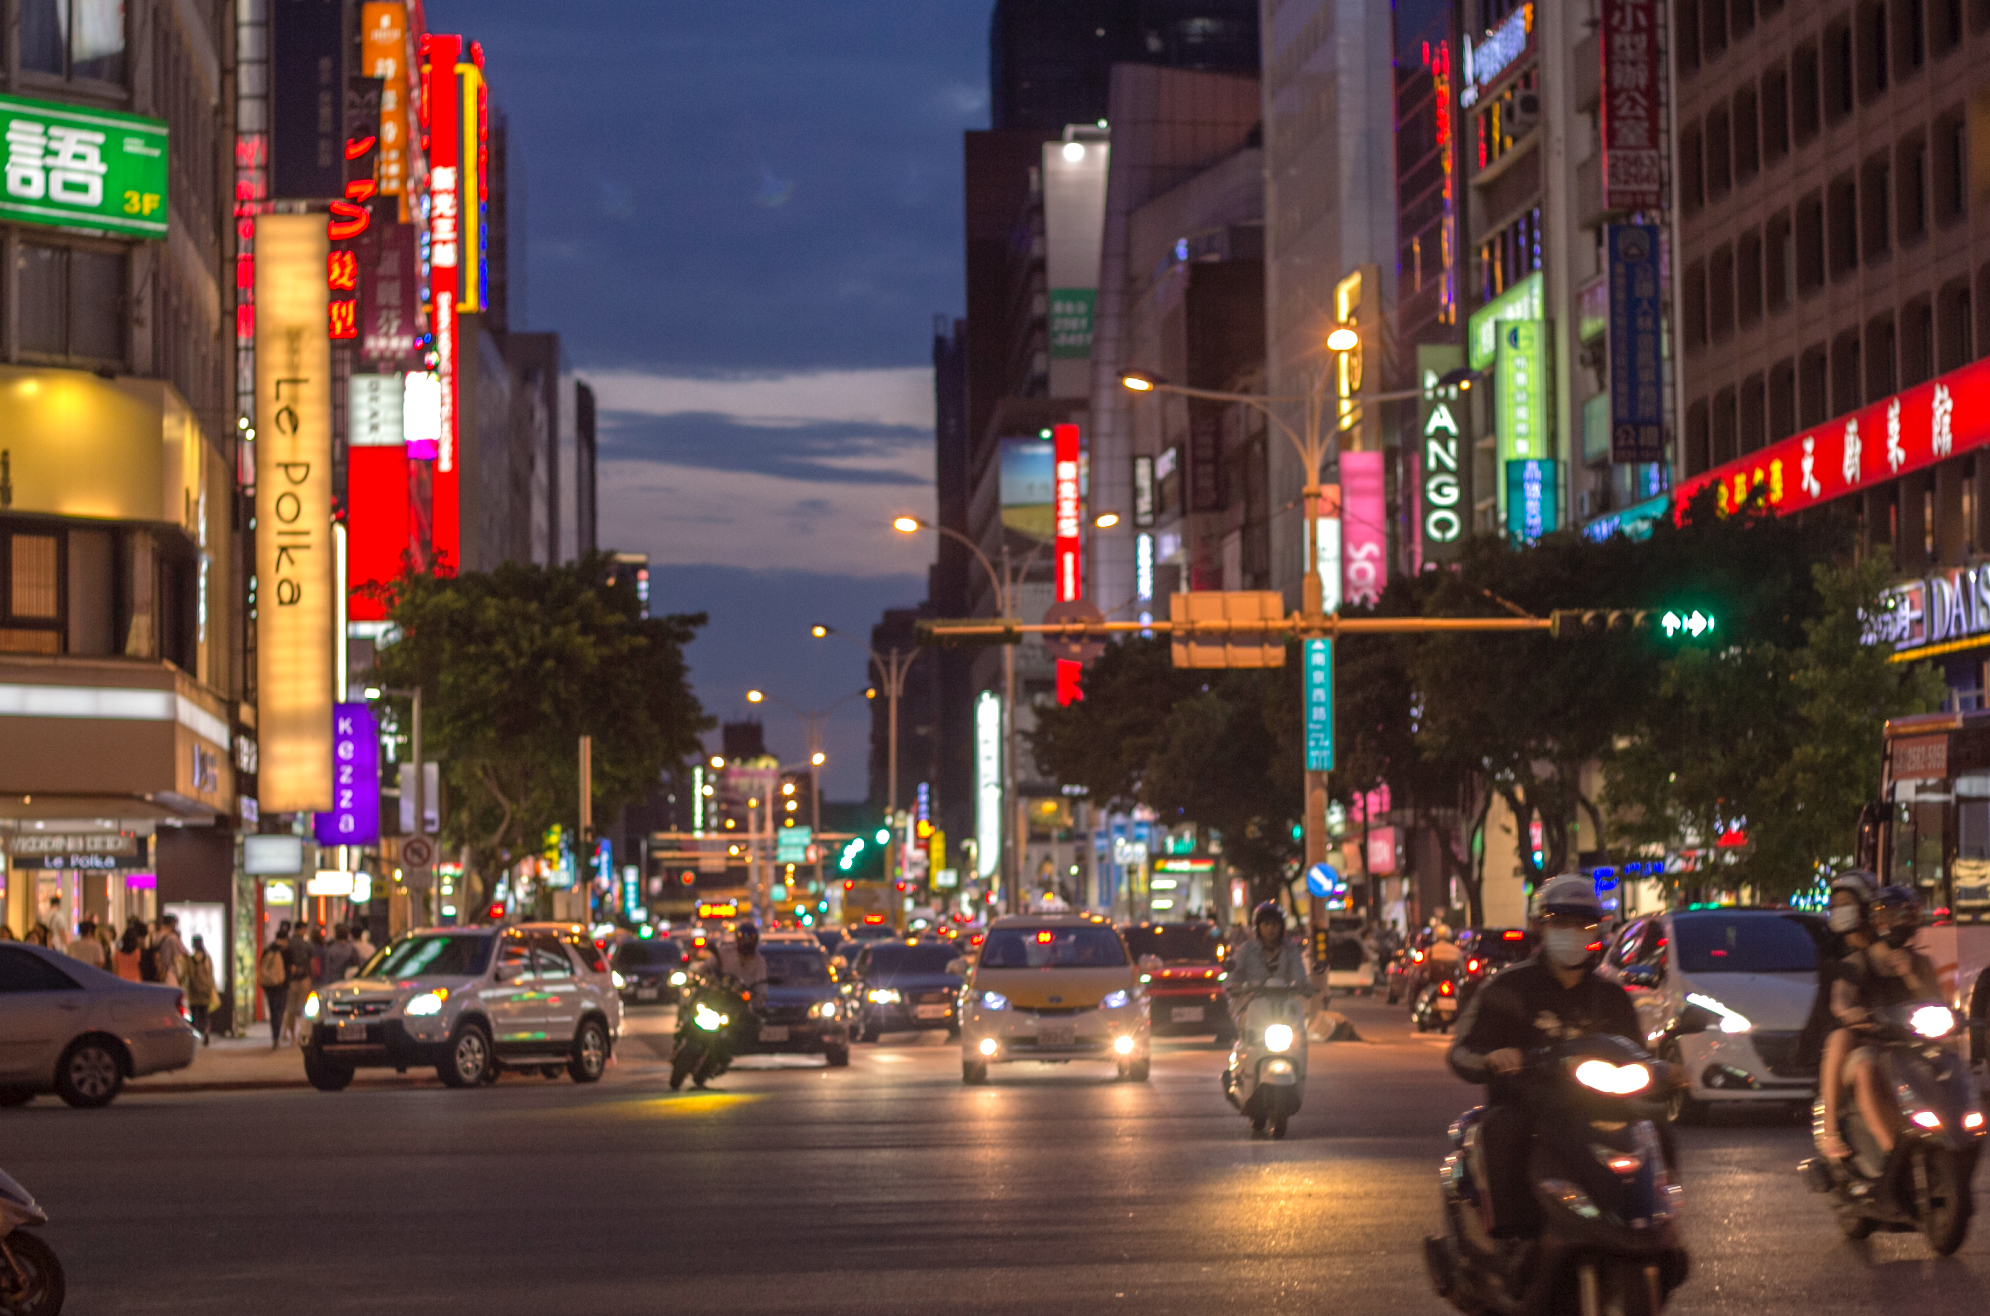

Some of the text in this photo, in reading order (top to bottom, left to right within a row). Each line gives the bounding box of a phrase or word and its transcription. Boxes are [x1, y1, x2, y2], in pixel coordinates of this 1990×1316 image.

[5, 119, 108, 208] 語
[123, 190, 161, 216] 3F
[275, 378, 312, 606] Le Polka
[44, 853, 116, 869] Le Polka
